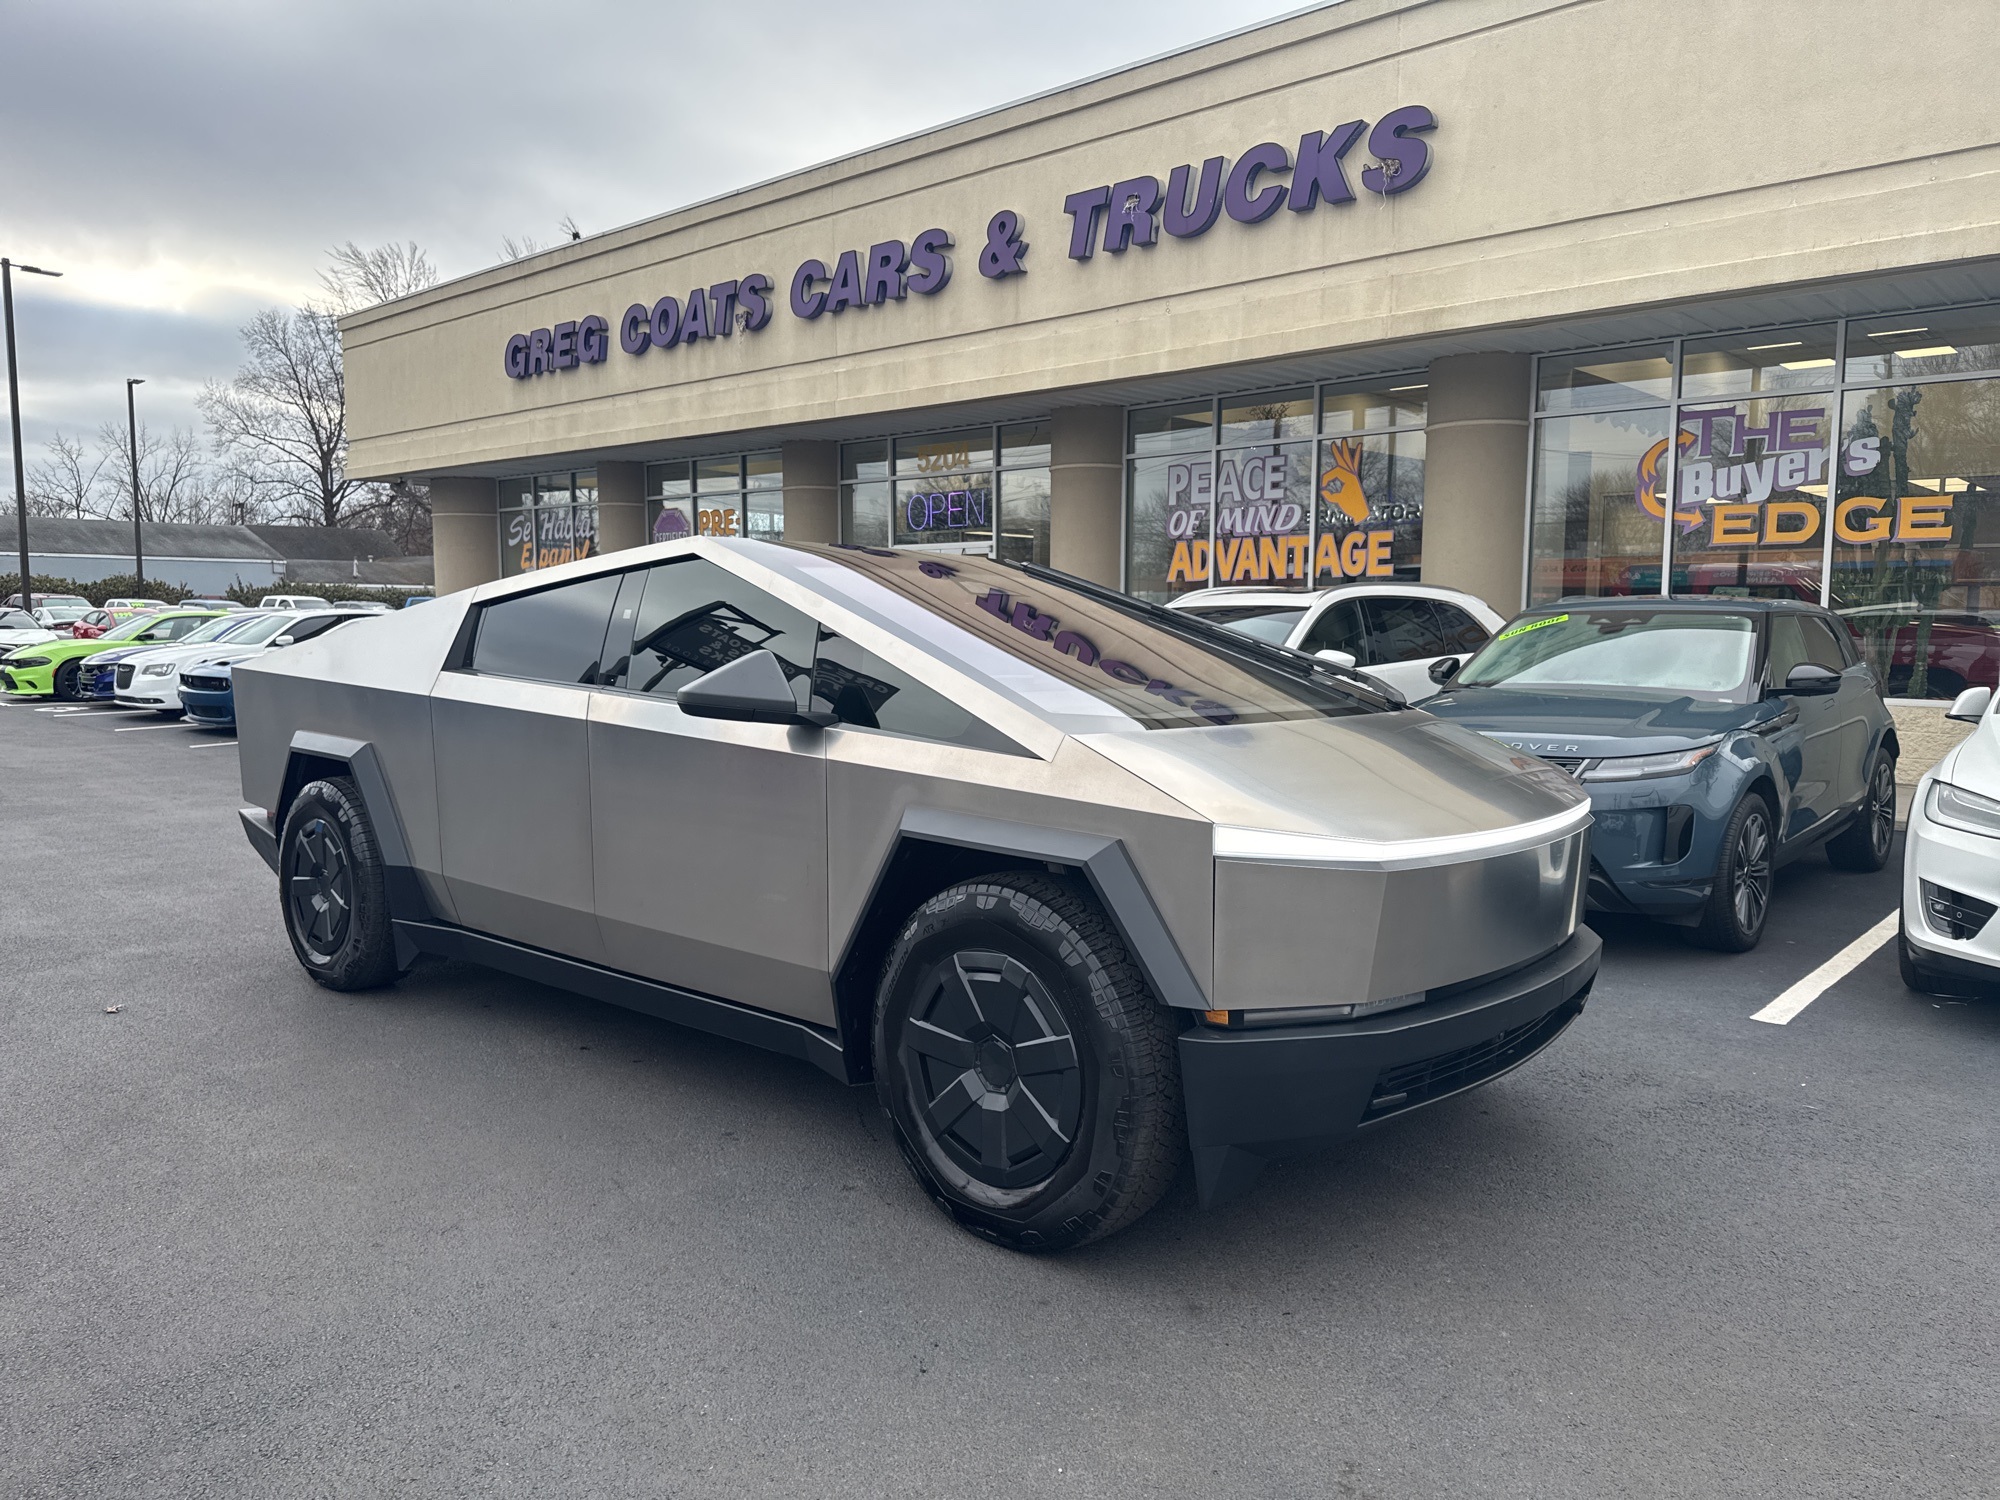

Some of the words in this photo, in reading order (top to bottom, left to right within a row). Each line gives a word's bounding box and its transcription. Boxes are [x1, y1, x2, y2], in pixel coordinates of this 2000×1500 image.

[504, 314, 608, 379] GREG
[620, 273, 774, 355] COATS
[790, 227, 955, 319] CARS
[979, 209, 1029, 279] &
[1063, 105, 1438, 260] TRUCKS
[917, 442, 970, 472] 5204
[1680, 406, 1825, 459] THE
[1168, 455, 1288, 505] PEACE
[1681, 436, 1880, 507] Buyer's
[508, 515, 531, 546] Se
[540, 510, 594, 540] Habla
[908, 489, 985, 530] OPEN
[1167, 509, 1205, 539] OF
[1217, 504, 1301, 537] MIND
[1708, 494, 1955, 546] EDGE
[1166, 530, 1395, 582] ADVANTAGE
[1511, 742, 1579, 752] OVER
